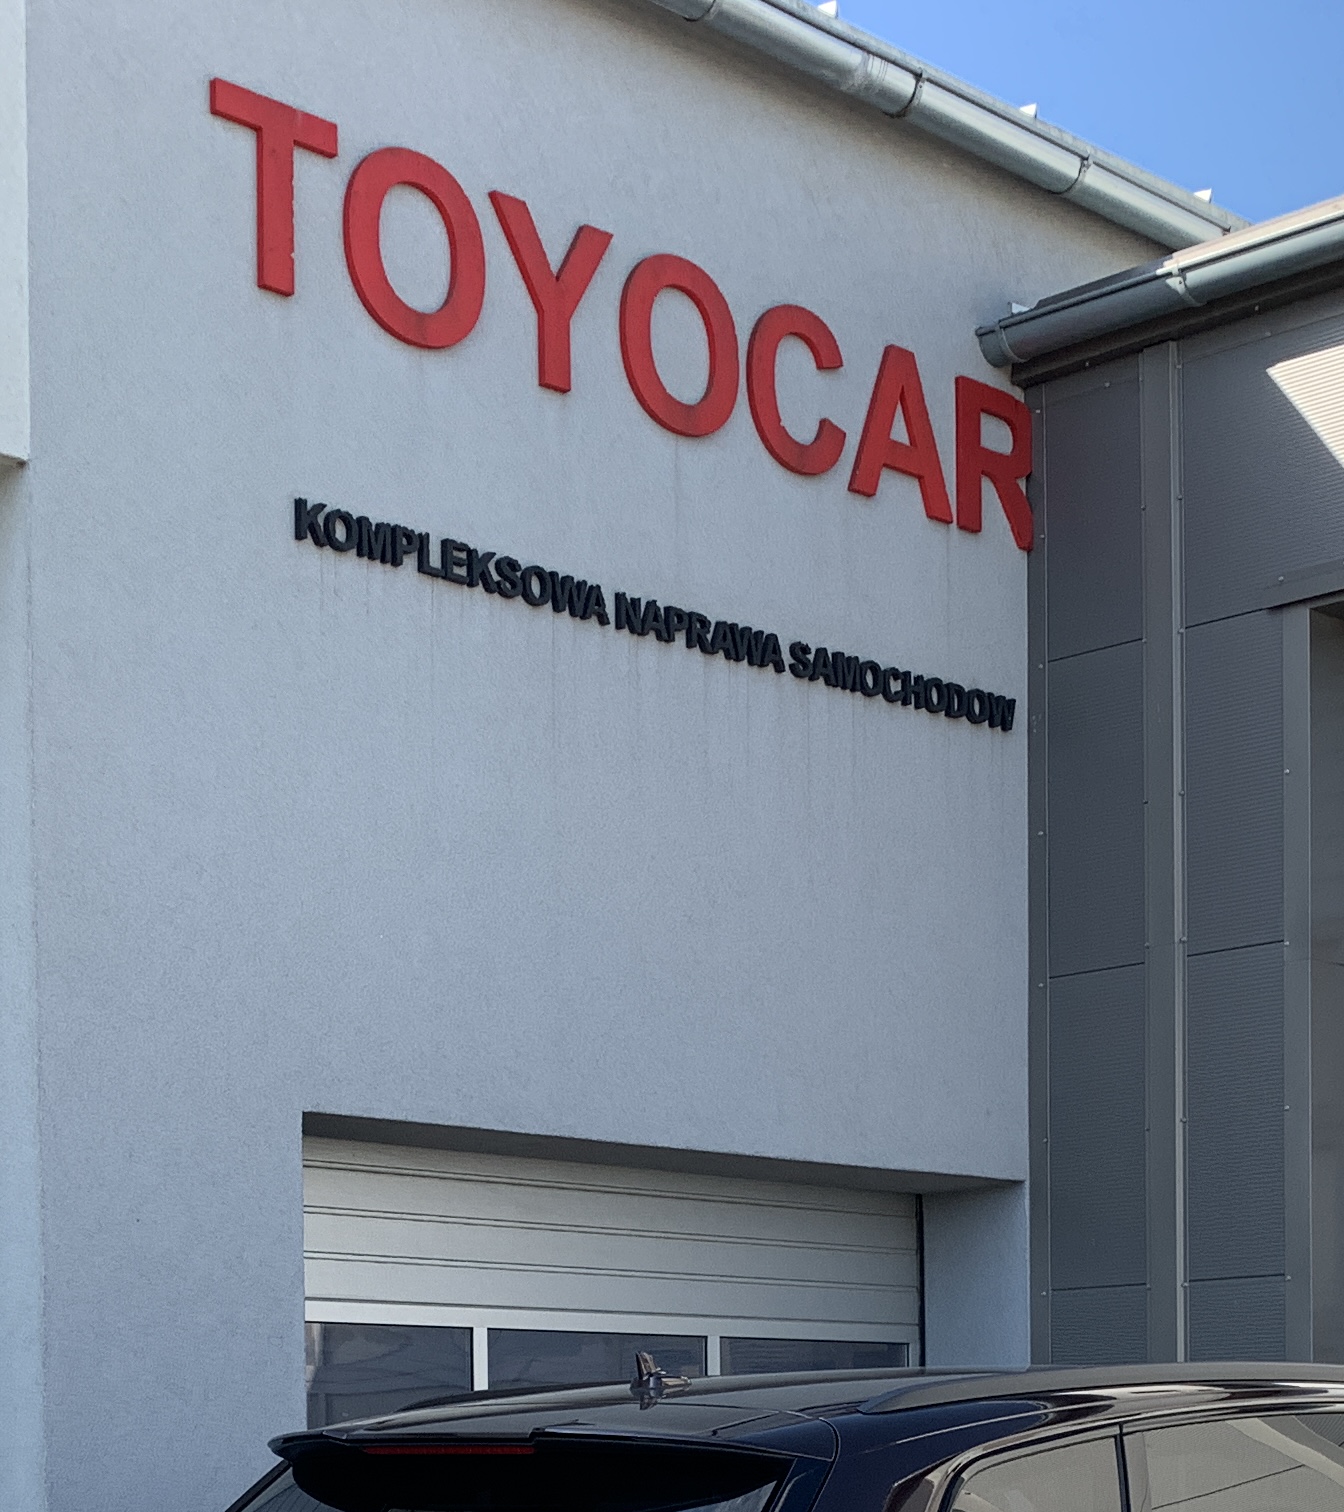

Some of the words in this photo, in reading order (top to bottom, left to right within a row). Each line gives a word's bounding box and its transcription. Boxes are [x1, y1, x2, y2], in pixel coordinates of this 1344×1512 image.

[209, 78, 1034, 552] TOYOCAR
[294, 497, 609, 626] KOMPLEKSOWA
[614, 591, 785, 673] NAPRAWA
[788, 641, 1016, 731] SAMOCHODOW
